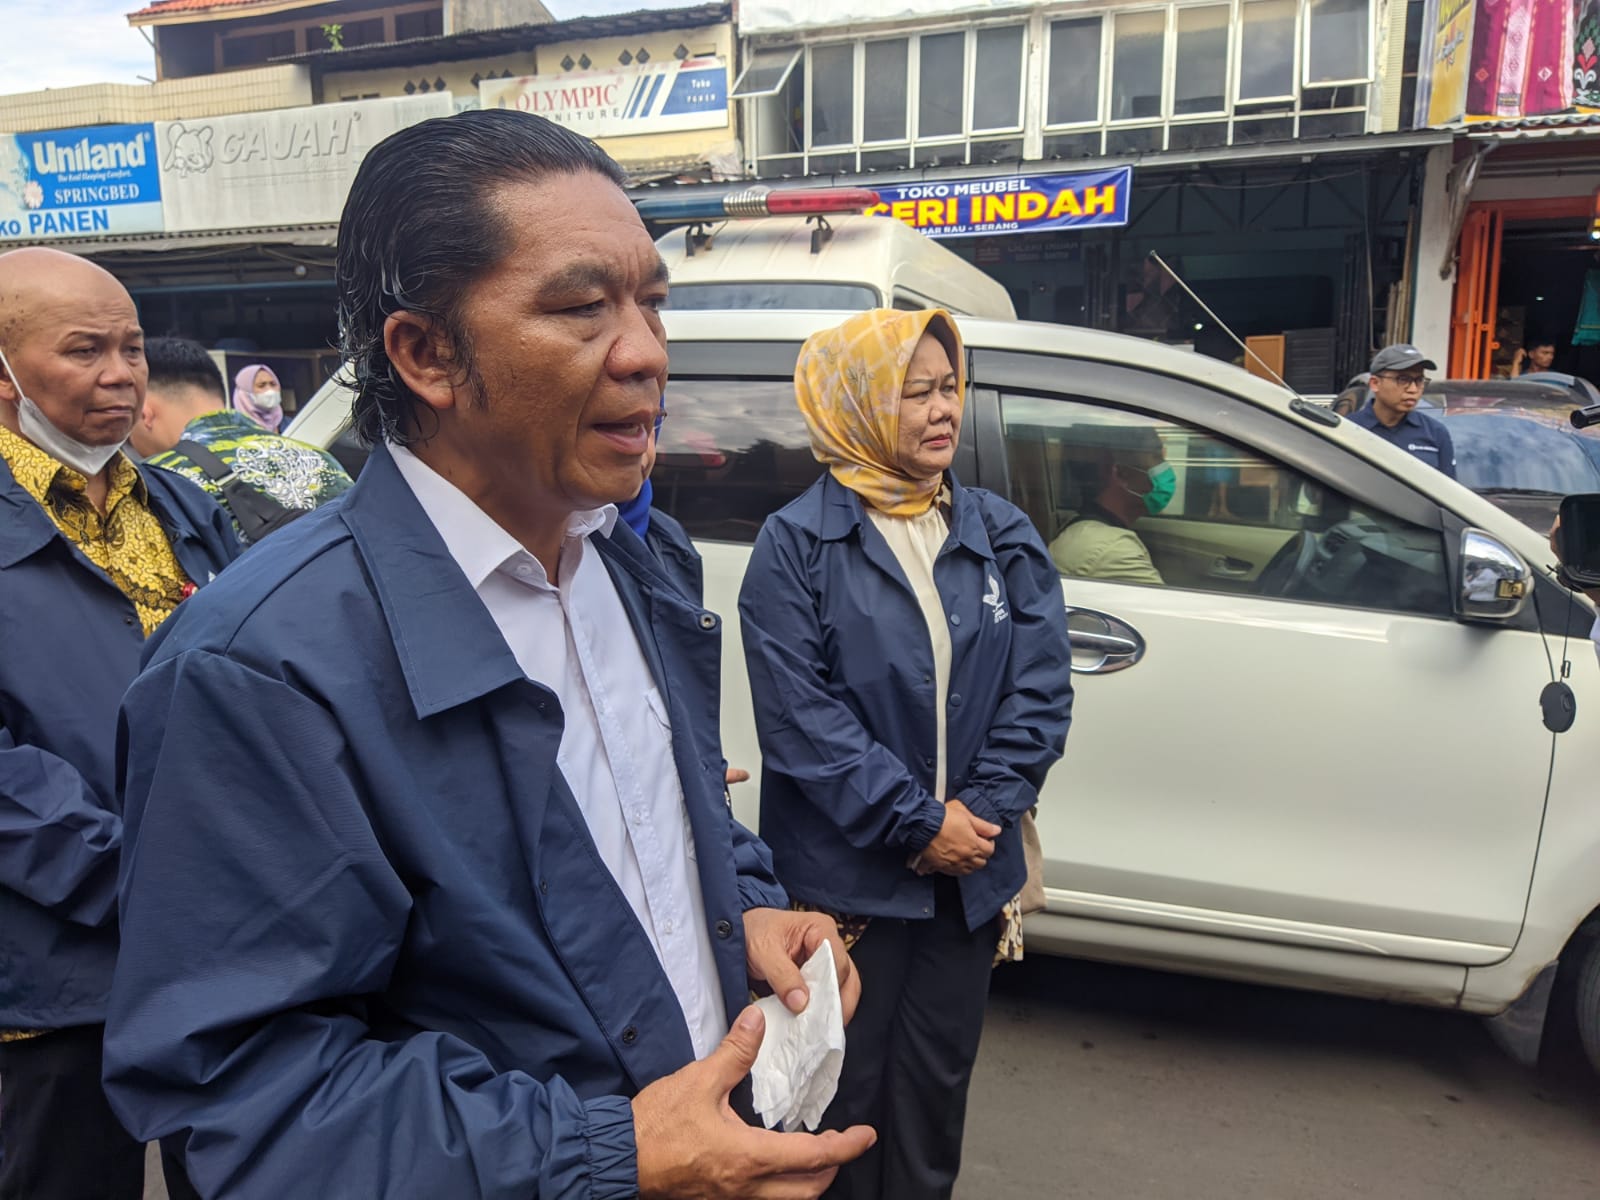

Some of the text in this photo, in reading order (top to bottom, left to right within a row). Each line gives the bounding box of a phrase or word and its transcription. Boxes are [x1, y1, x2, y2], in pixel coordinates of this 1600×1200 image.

[515, 83, 619, 112] OLYMPIC
[32, 132, 147, 175] Uniland
[219, 117, 353, 165] GAJAH
[54, 183, 140, 205] SPRINGBED
[897, 179, 1031, 199] TOKO MEUBEL
[970, 184, 1117, 224] INDAH
[28, 208, 110, 235] PANEN
[974, 221, 1018, 232] SERANG
